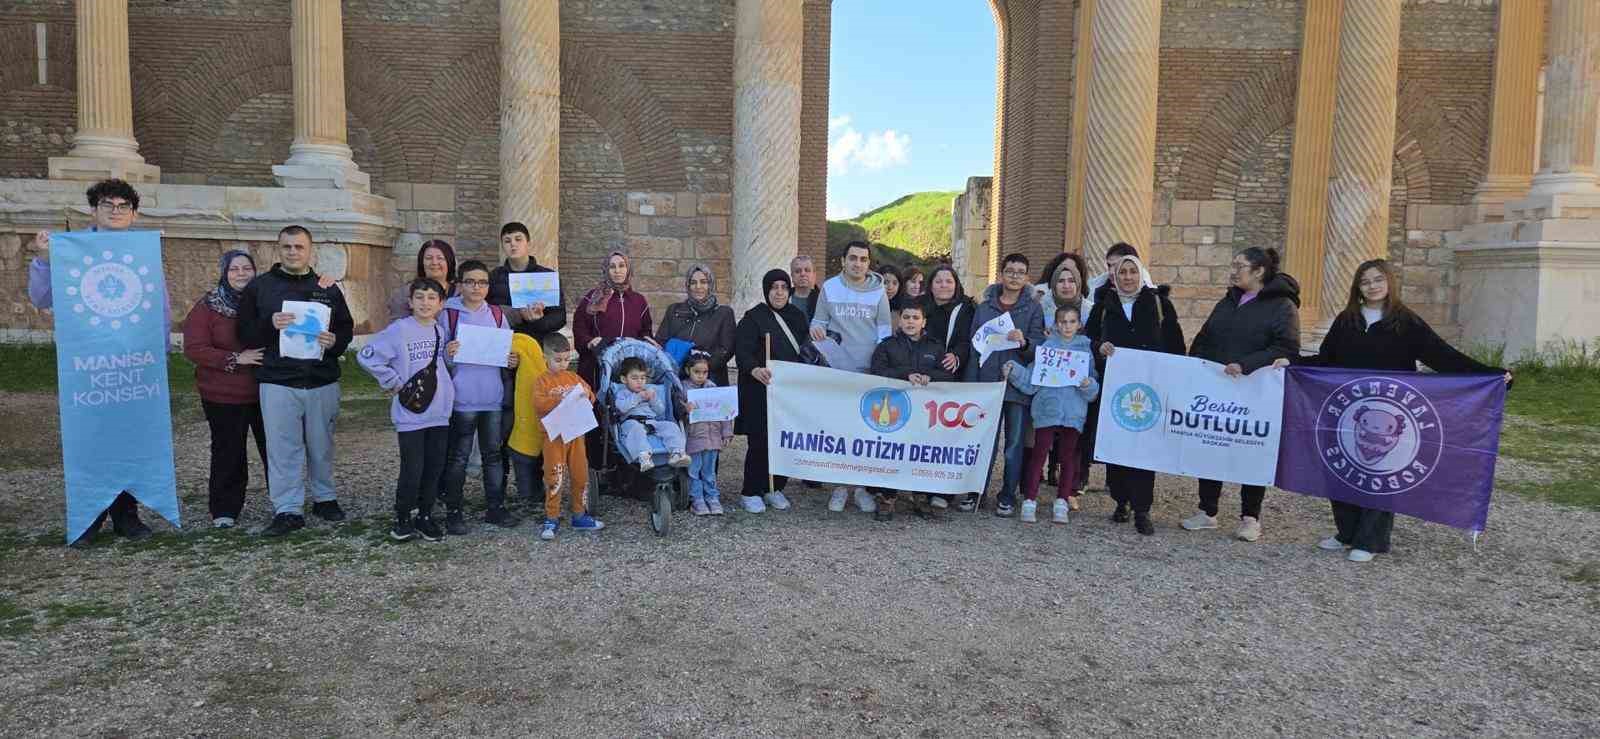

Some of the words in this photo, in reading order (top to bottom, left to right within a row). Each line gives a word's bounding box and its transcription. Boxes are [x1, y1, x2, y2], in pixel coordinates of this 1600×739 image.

[73, 350, 156, 371] MANİSA
[90, 368, 145, 388] KENT
[73, 378, 161, 407] KONSEYİ
[1191, 394, 1250, 416] Besim
[1170, 409, 1270, 438] DUTLULU
[780, 430, 847, 455] MANİSA
[852, 435, 905, 461] OTİZM
[909, 443, 981, 466] DERNEĞİ
